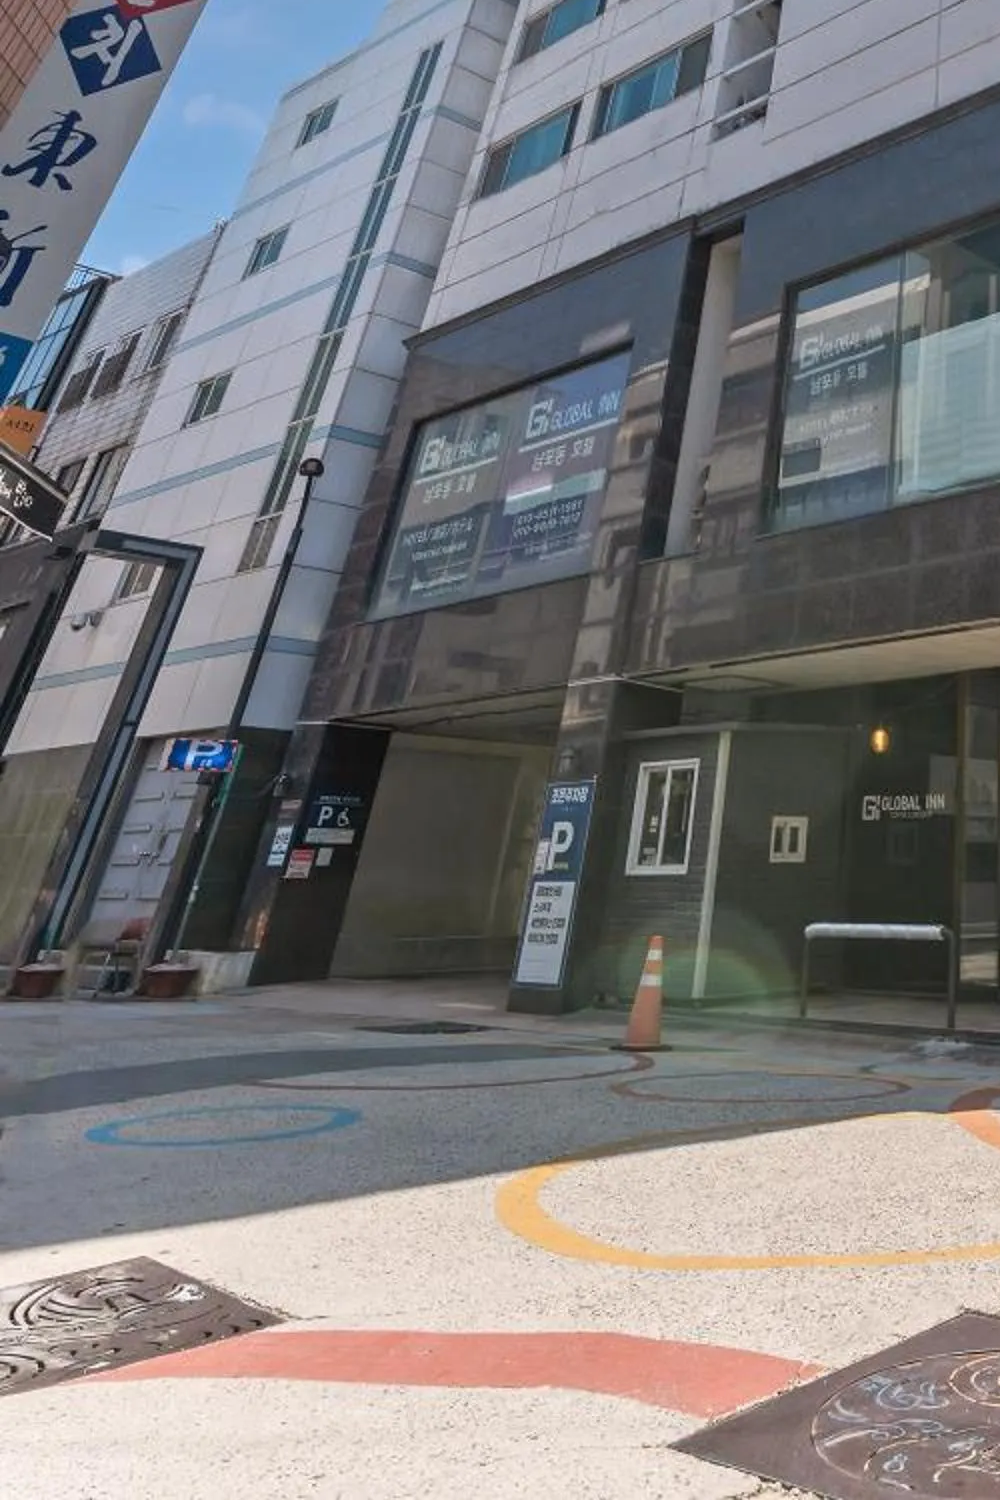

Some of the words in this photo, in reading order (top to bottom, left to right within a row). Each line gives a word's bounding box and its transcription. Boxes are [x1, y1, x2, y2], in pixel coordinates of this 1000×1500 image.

[881, 794, 921, 811] GLOBAL
[925, 793, 946, 810] INN
[317, 805, 334, 827] P
[546, 820, 575, 871] P
